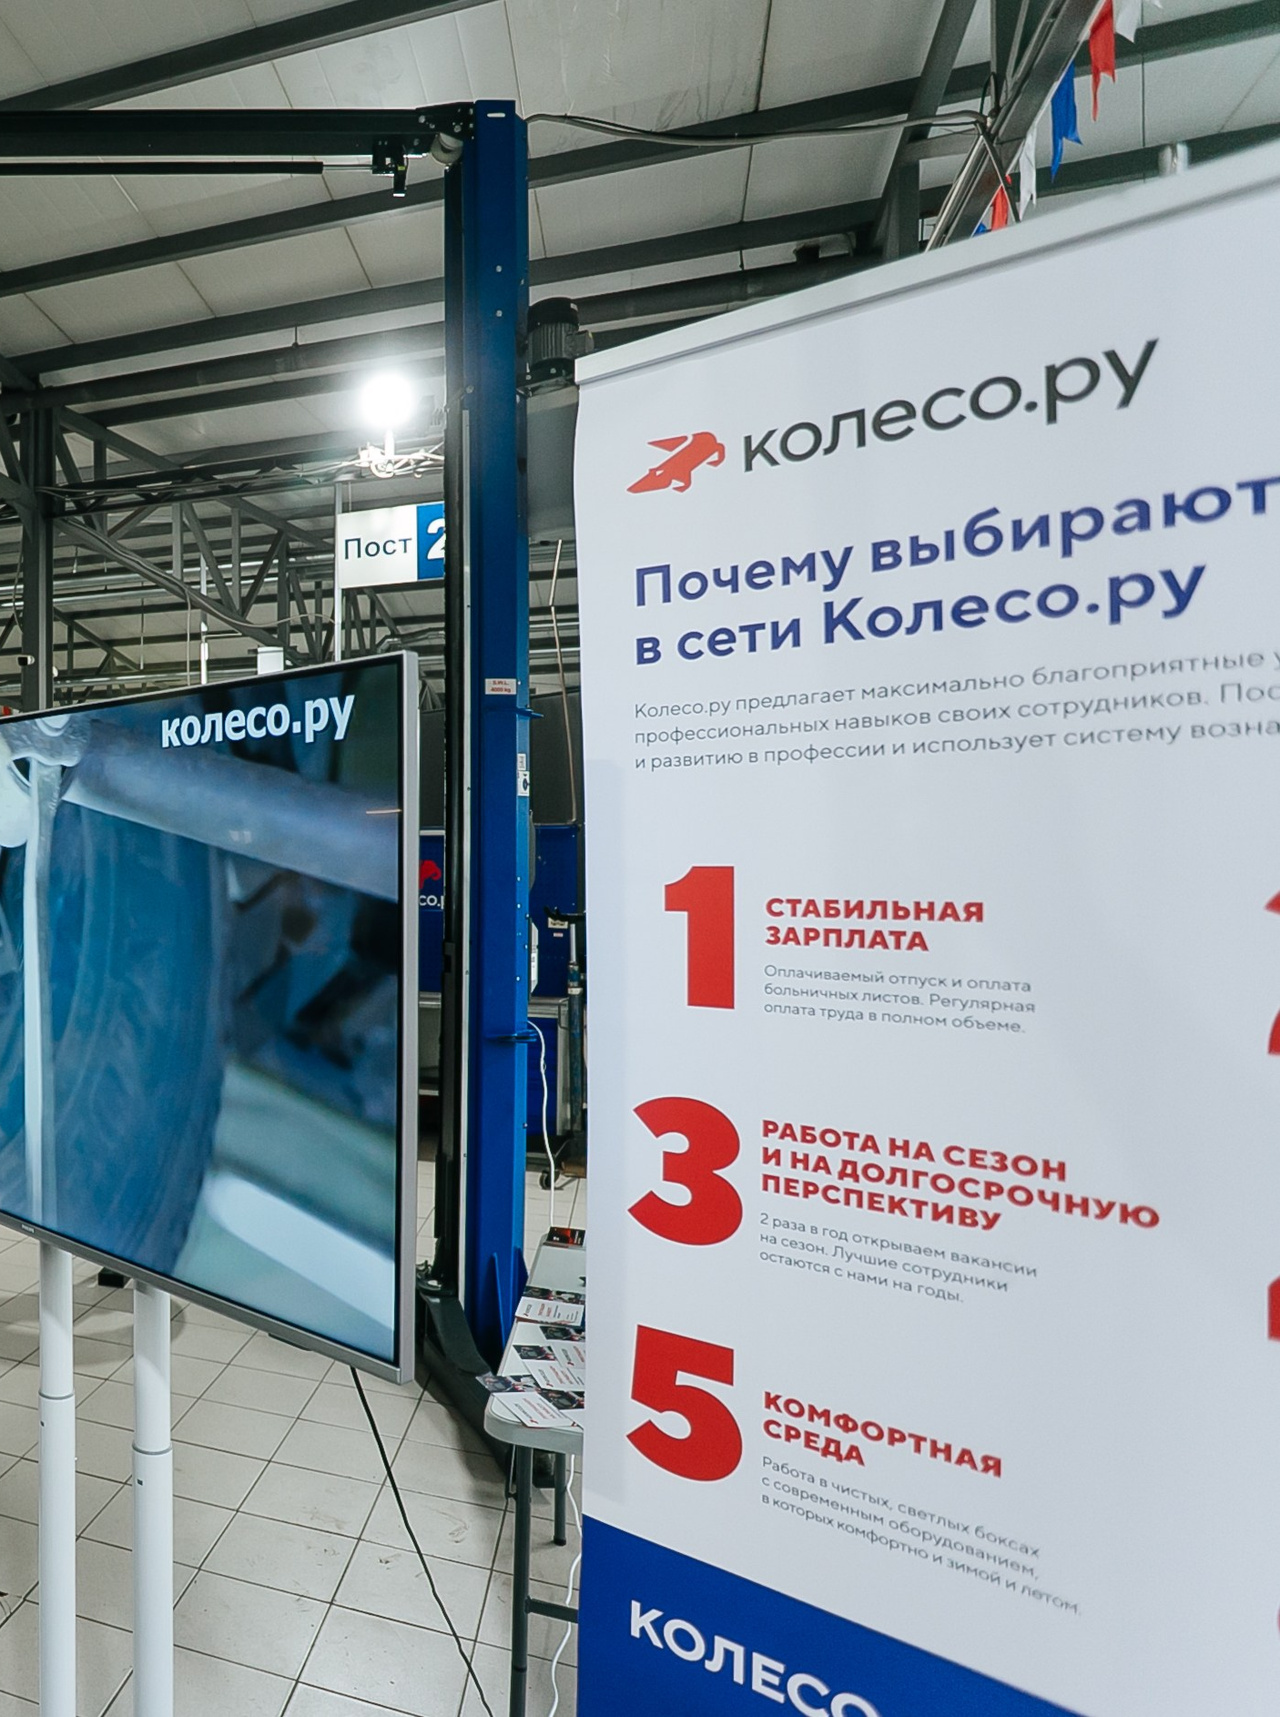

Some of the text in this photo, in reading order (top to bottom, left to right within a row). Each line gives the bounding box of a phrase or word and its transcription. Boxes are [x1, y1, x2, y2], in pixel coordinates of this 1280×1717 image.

[742, 338, 1159, 472] колесо.ру
[344, 517, 446, 560] Пост 2
[635, 475, 1280, 606] Почему выбирают
[635, 564, 1206, 665] в сети Колесо.ру
[634, 698, 731, 719] Колесо.ру
[736, 687, 855, 713] предлагает
[861, 674, 1025, 700] максимально
[1032, 652, 1265, 686] благоприятные
[160, 692, 356, 750] колесо.ру
[634, 719, 830, 747] профессиональных
[835, 709, 932, 730] навыков
[938, 705, 1011, 723] своих
[1017, 690, 1209, 719] сотрудников.
[635, 758, 646, 769] и
[651, 753, 743, 772] развитию
[749, 752, 759, 763] в
[764, 742, 885, 765] профессии
[892, 743, 906, 754] и
[912, 732, 1057, 754] использует
[1063, 724, 1182, 745] систему
[663, 865, 735, 1010] 1
[765, 898, 984, 923] СТАБИЛЬНАЯ
[765, 926, 929, 952] ЗАРПЛАТА
[764, 964, 1032, 992] Оплачиваемый отпуск и оплата
[764, 983, 1036, 1013] больничных листов. Регулярная
[764, 1003, 816, 1017] оплата
[820, 1008, 864, 1022] труда
[868, 1012, 877, 1021] в
[881, 1013, 947, 1027] полном
[627, 1097, 743, 1246] 3
[761, 1119, 1067, 1182] РАБОТА НА СЕЗОН
[761, 1147, 1160, 1230] И НА ДОЛГОСРОЧНУЮ
[761, 1173, 1002, 1231] ПЕРСПЕКТИВУ
[760, 1213, 1038, 1277] 2 раза в год открываем вакансии
[760, 1233, 1008, 1293] на сезон. Лучшие сотрудники
[759, 1250, 964, 1303] остаются с нами на годы.
[626, 1324, 743, 1482] 5
[763, 1391, 1003, 1478] КОМФОРТНАЯ
[763, 1419, 866, 1467] СРЕДА
[762, 1476, 771, 1487] с
[773, 1481, 884, 1526] современным
[762, 1456, 1040, 1558] Работа в чистых, светлых боксах
[762, 1494, 770, 1504] в
[773, 1498, 835, 1528] которых
[837, 1520, 929, 1560] комфортно
[932, 1553, 943, 1566] и
[947, 1557, 1001, 1586] зимой
[1005, 1579, 1017, 1592] и
